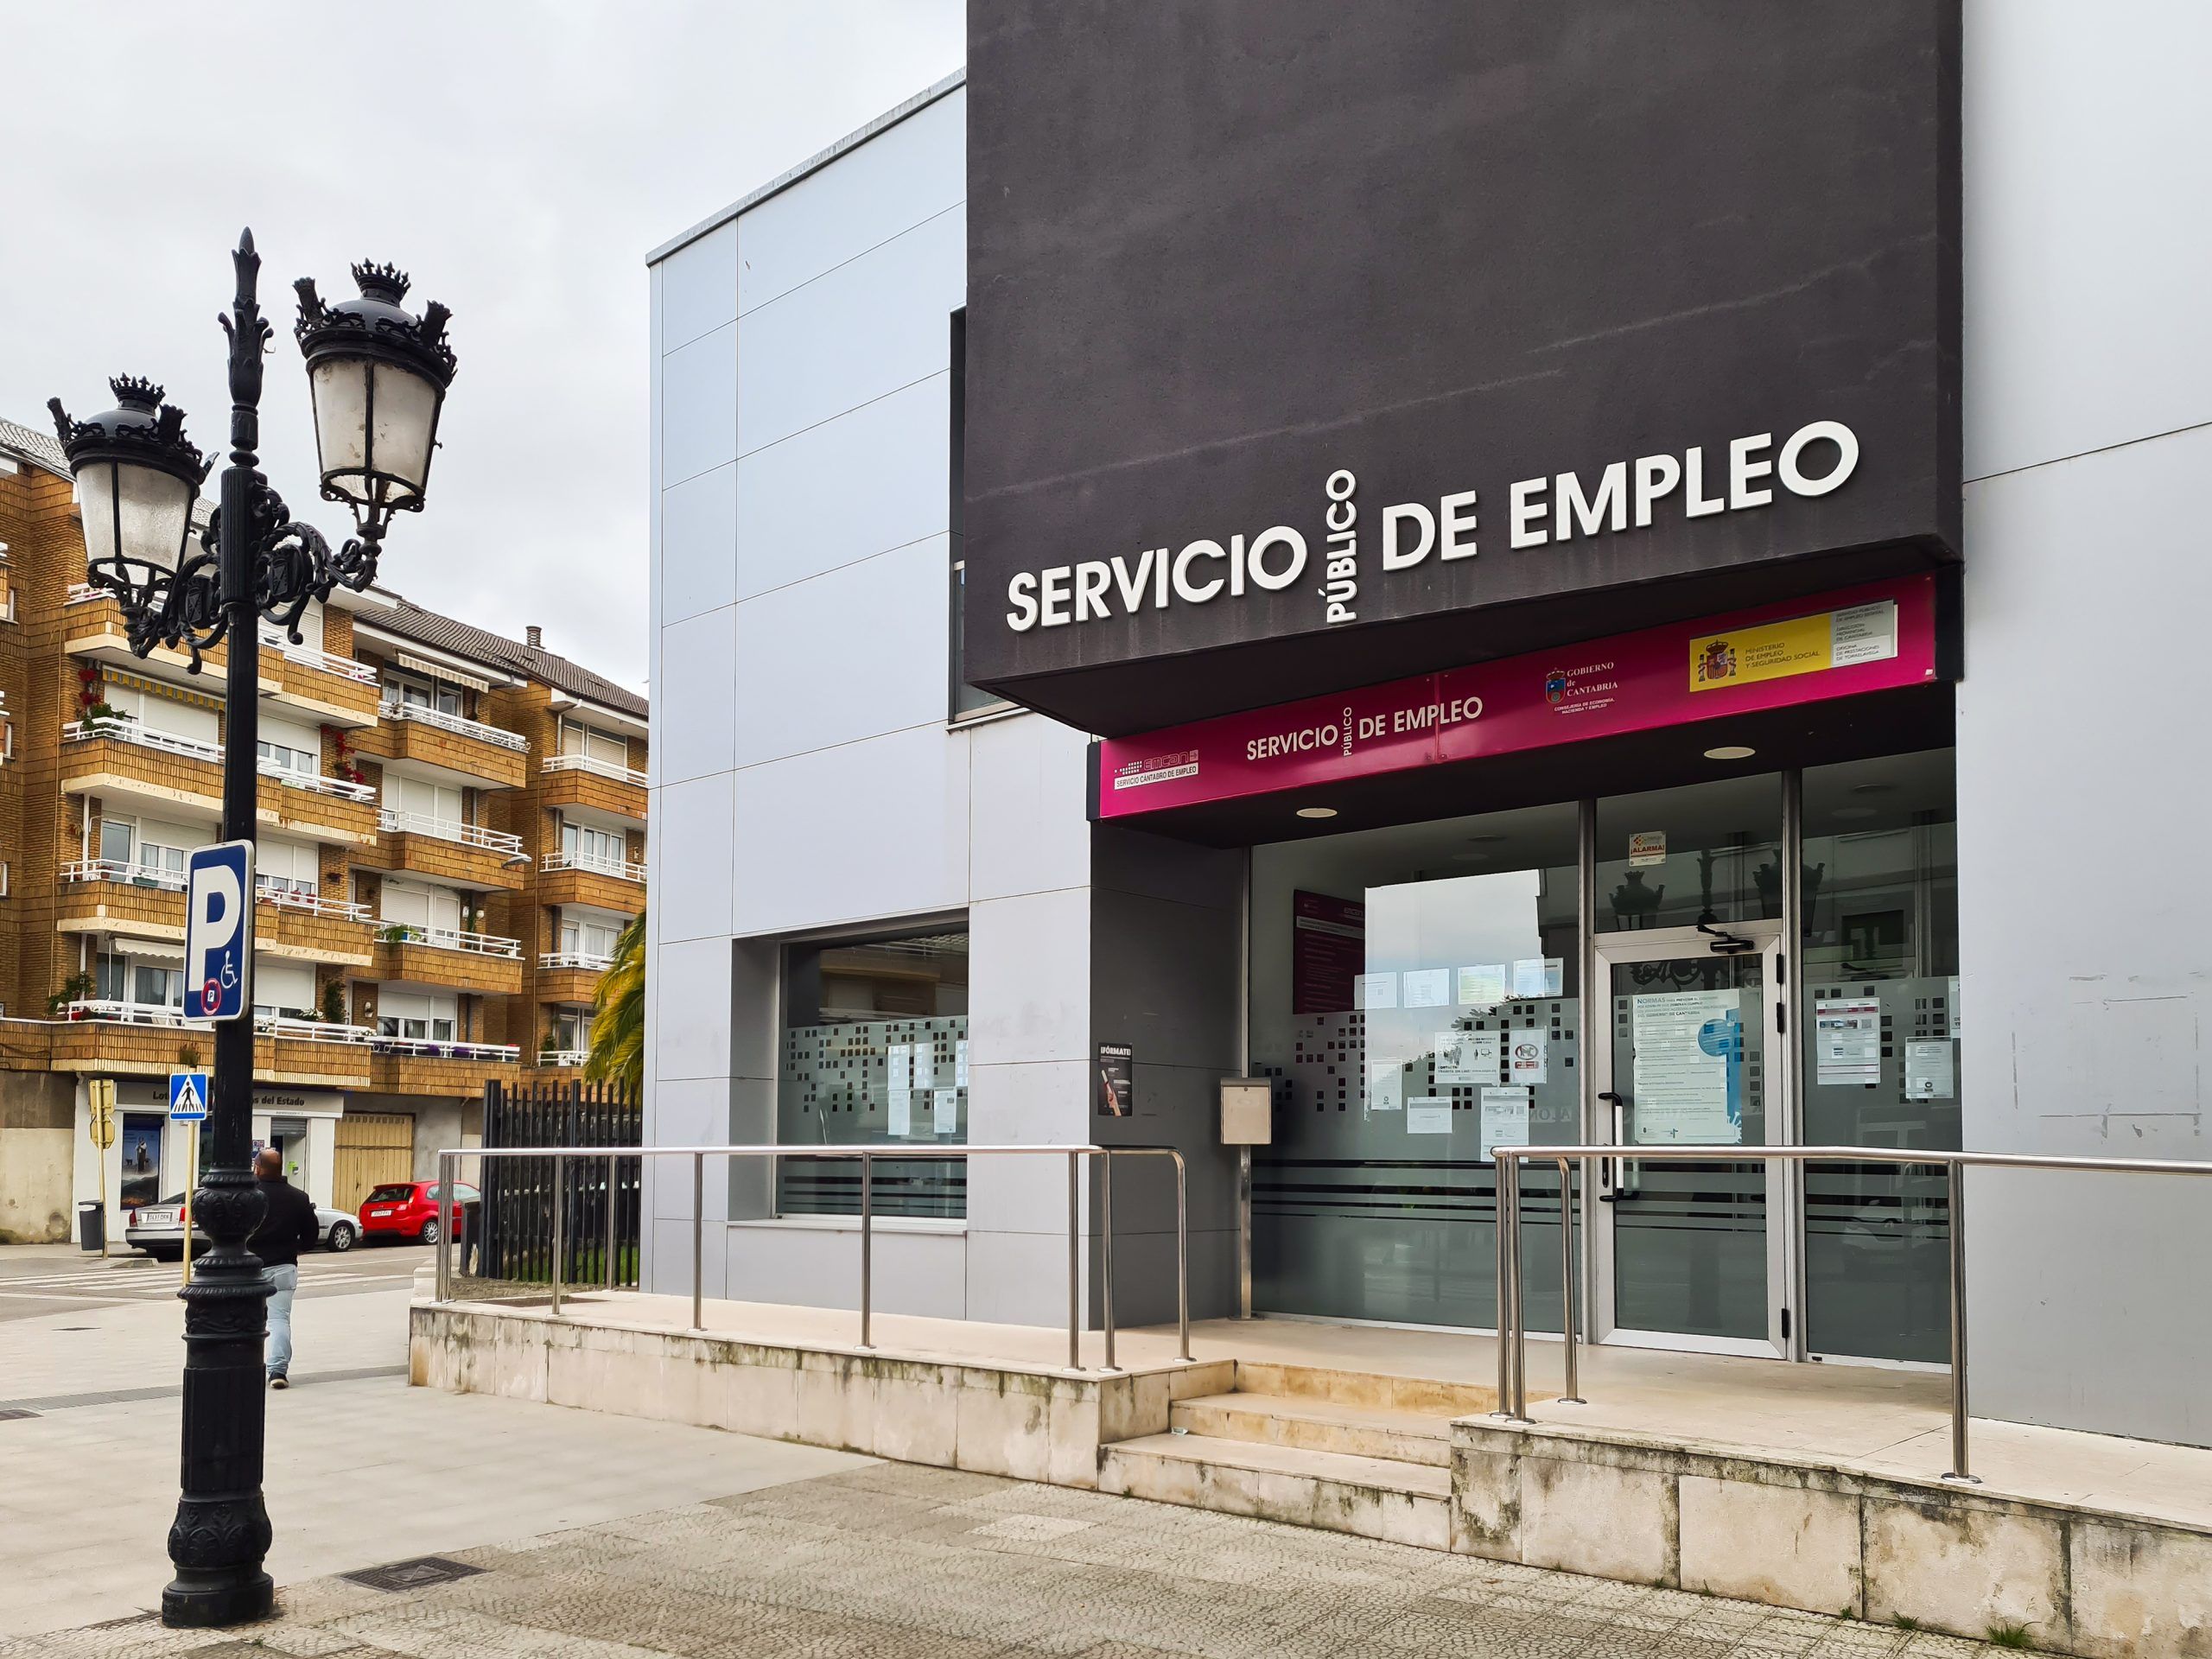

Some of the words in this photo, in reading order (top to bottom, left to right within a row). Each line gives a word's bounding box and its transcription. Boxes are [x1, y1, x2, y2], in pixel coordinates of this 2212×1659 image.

[1006, 525, 1308, 632] SERVICIO
[1318, 468, 1357, 624] PÚBLICO
[1382, 490, 1478, 572] DE
[1510, 420, 1859, 550] EMPLEO
[1745, 642, 1785, 654] MINISTERIO
[1757, 650, 1784, 660] EMPLEO
[1751, 656, 1792, 668] SEGURIDAD
[1794, 651, 1821, 660] SOCIAL
[1567, 662, 1614, 677] GOBIERNO
[1567, 681, 1618, 697] CANTABRIA
[1247, 724, 1338, 760] SERVICIO
[1341, 707, 1352, 757] PÚBLICO
[1359, 715, 1386, 740] DE
[1394, 696, 1484, 733] EMPLEO
[1116, 777, 1140, 787] SERVICIO
[1175, 766, 1197, 777] EMPLEO
[188, 865, 241, 993] P
[261, 1096, 275, 1105] del
[276, 1096, 305, 1106] Estado
